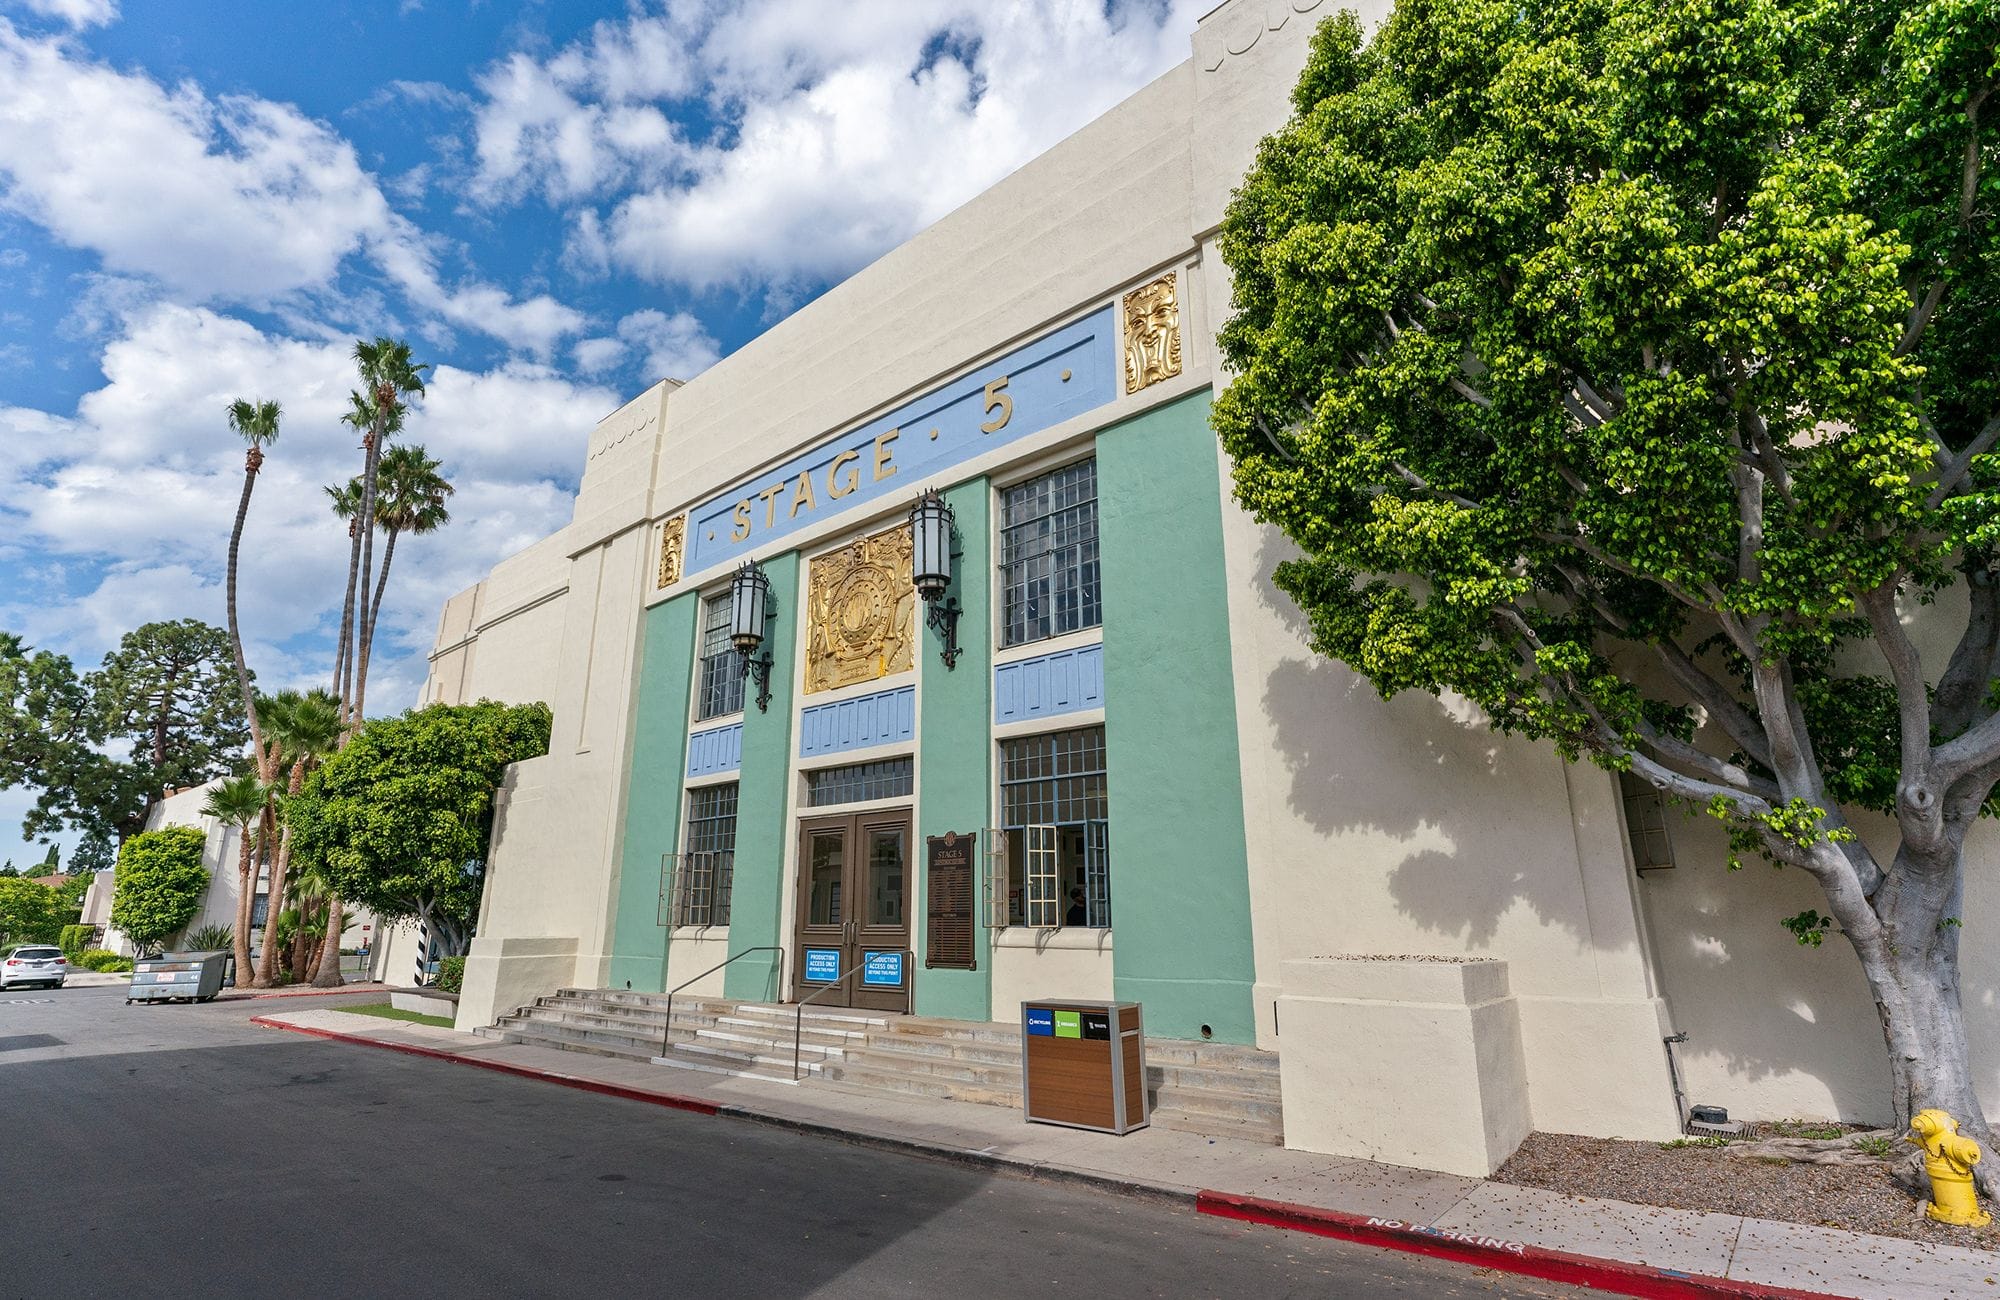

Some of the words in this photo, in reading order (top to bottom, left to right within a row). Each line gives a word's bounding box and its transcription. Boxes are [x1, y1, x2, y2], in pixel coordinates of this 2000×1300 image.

[731, 428, 899, 543] STAGE
[981, 376, 1013, 434] 5
[938, 850, 957, 859] STAGE
[1366, 1217, 1404, 1229] NO
